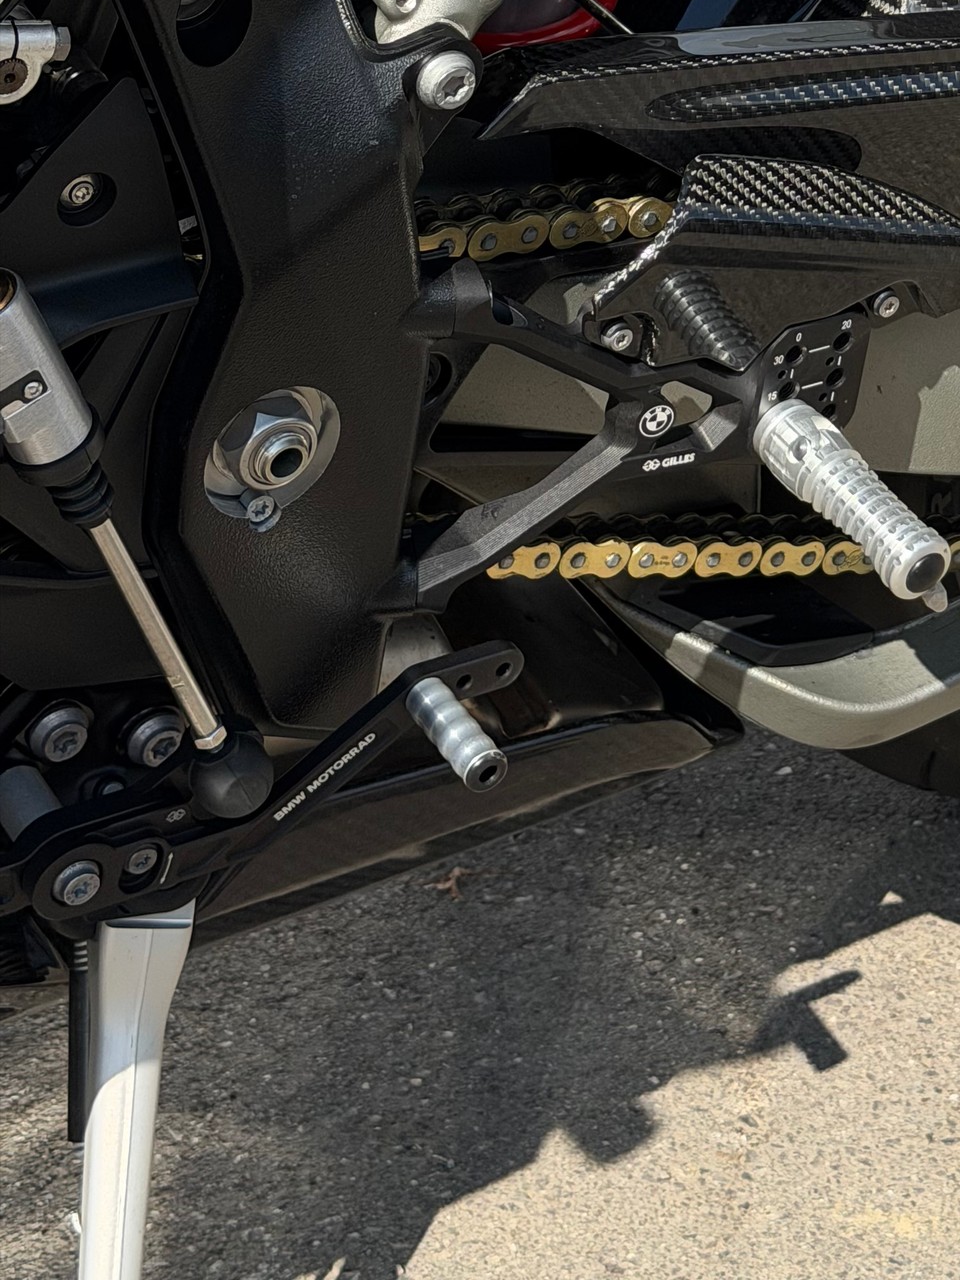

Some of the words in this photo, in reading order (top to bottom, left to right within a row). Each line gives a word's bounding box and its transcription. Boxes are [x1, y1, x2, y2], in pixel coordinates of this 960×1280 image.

[841, 319, 852, 330] 20
[795, 332, 802, 342] 0
[773, 354, 784, 365] 30
[767, 390, 778, 401] 15
[661, 452, 696, 467] GILLES
[272, 790, 306, 821] BMW
[306, 732, 377, 793] MOTORRAD
